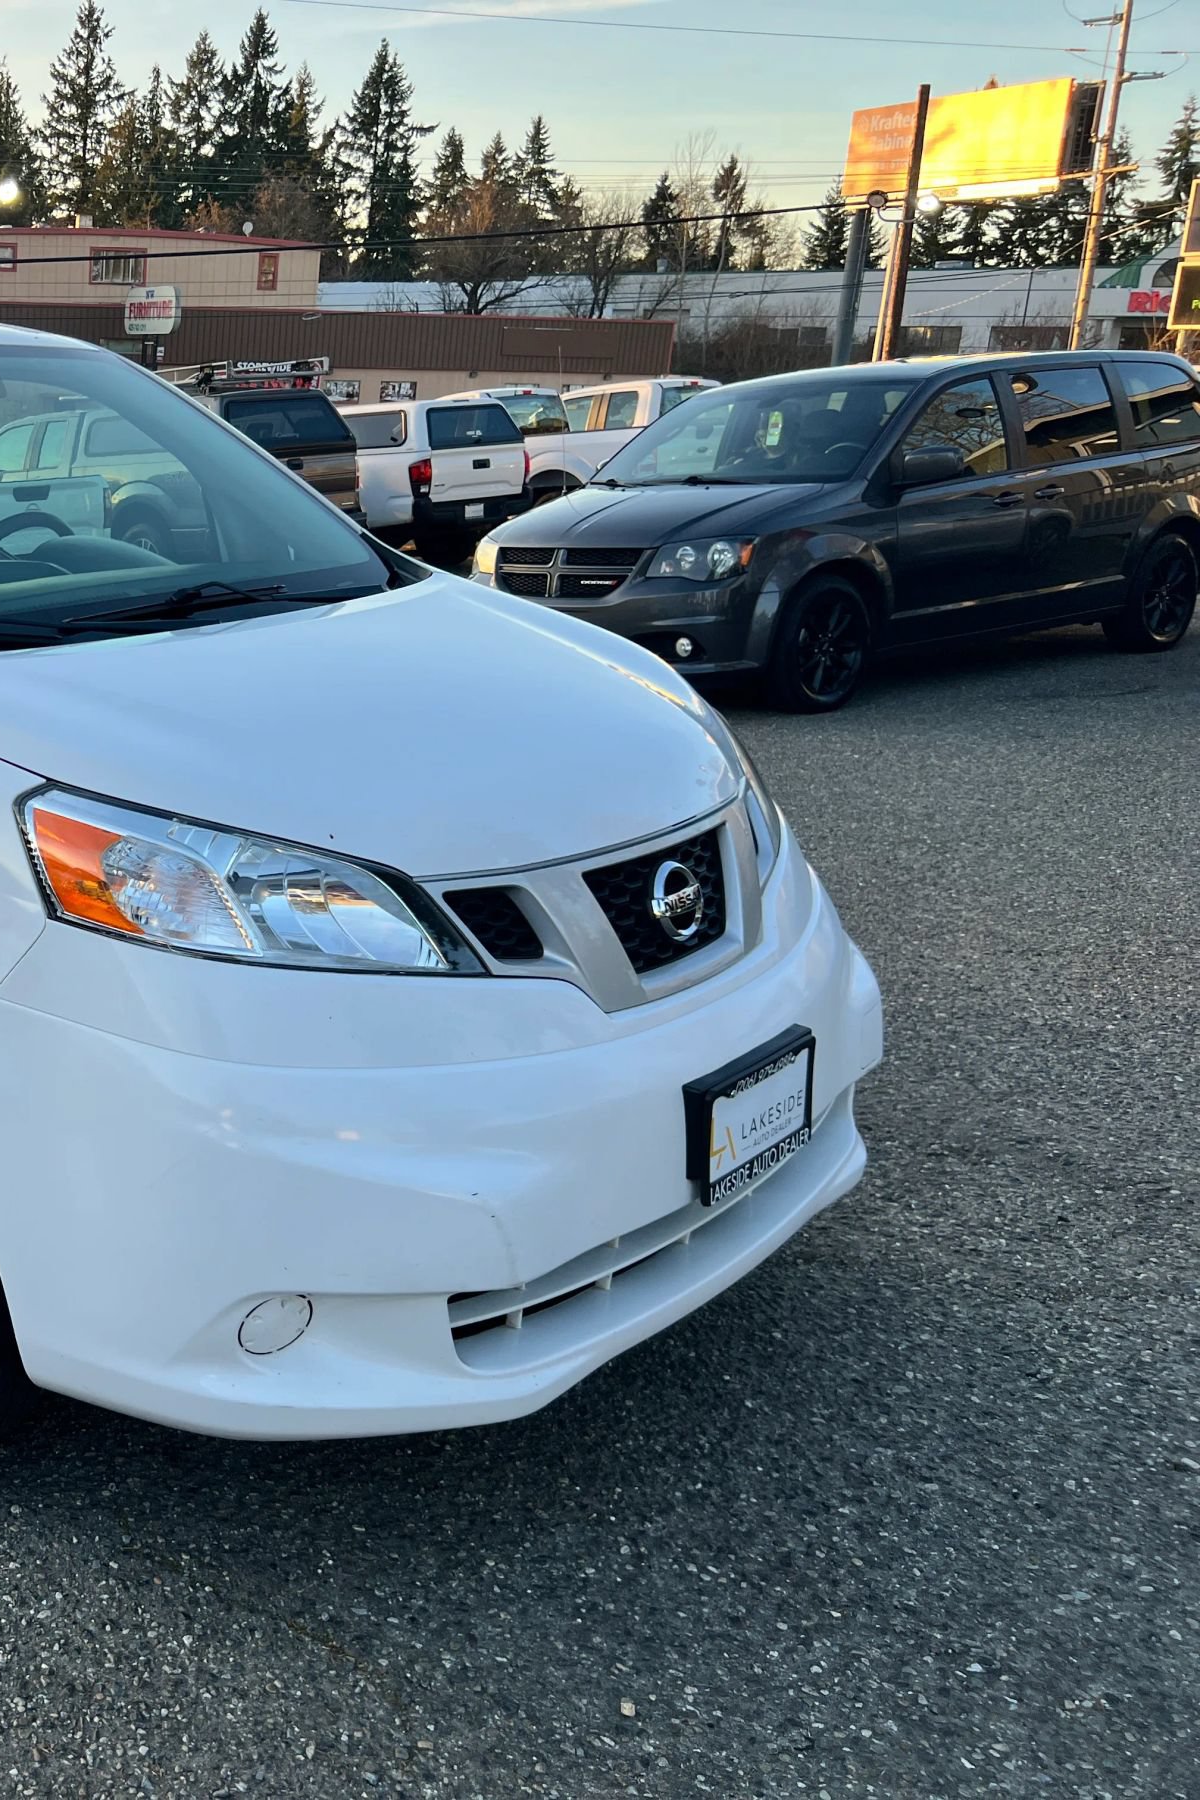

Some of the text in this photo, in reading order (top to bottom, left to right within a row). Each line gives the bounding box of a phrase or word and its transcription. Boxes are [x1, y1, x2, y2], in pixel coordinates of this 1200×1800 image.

[129, 300, 173, 320] FURNITURE
[237, 361, 293, 374] STOREWIDE
[741, 1089, 803, 1140] LAKESIDE
[752, 1118, 792, 1147] AUTO DEALER
[710, 1128, 809, 1205] LAKESIDE AUTO DEALER
